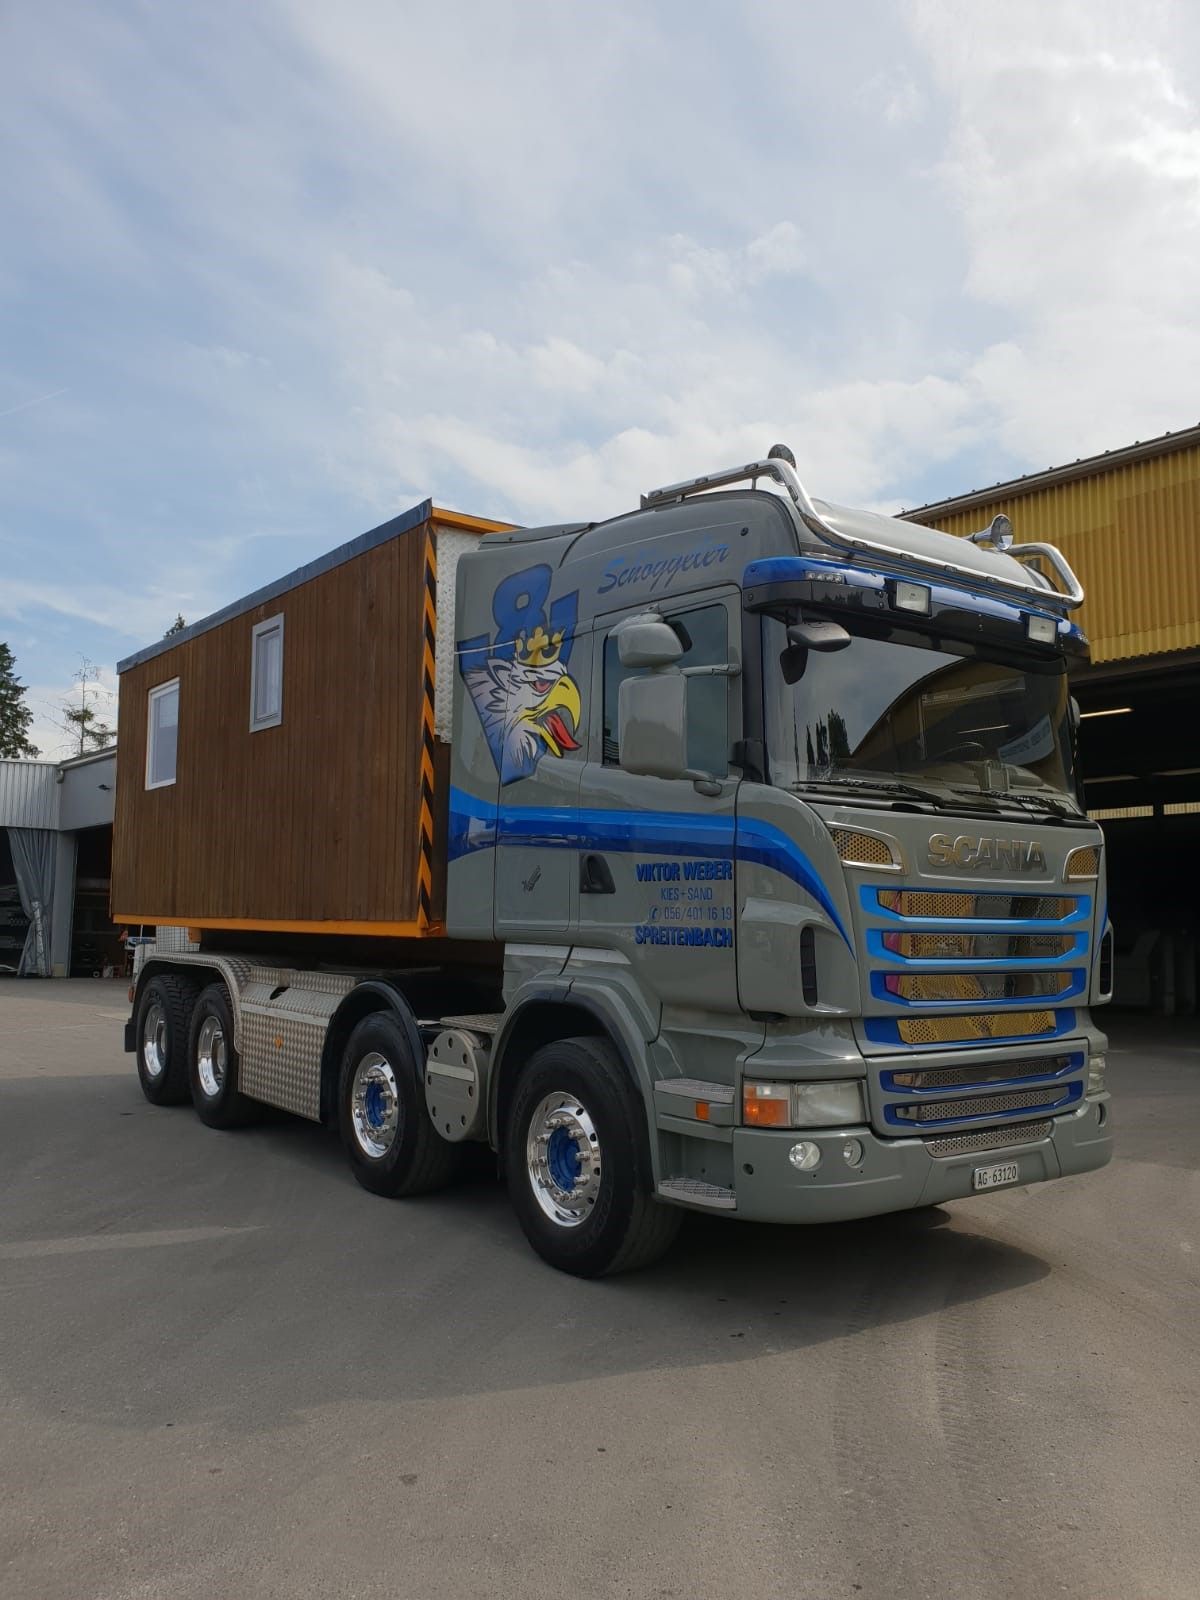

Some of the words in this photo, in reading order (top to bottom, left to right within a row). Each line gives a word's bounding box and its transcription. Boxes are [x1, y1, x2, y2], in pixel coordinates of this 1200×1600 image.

[928, 832, 1047, 872] SCANIA
[636, 863, 680, 882] VIKTOR
[683, 861, 732, 881] WEBER
[635, 926, 733, 947] SPREITENBACH
[978, 1171, 987, 1187] AG
[993, 1165, 1017, 1183] 63120
